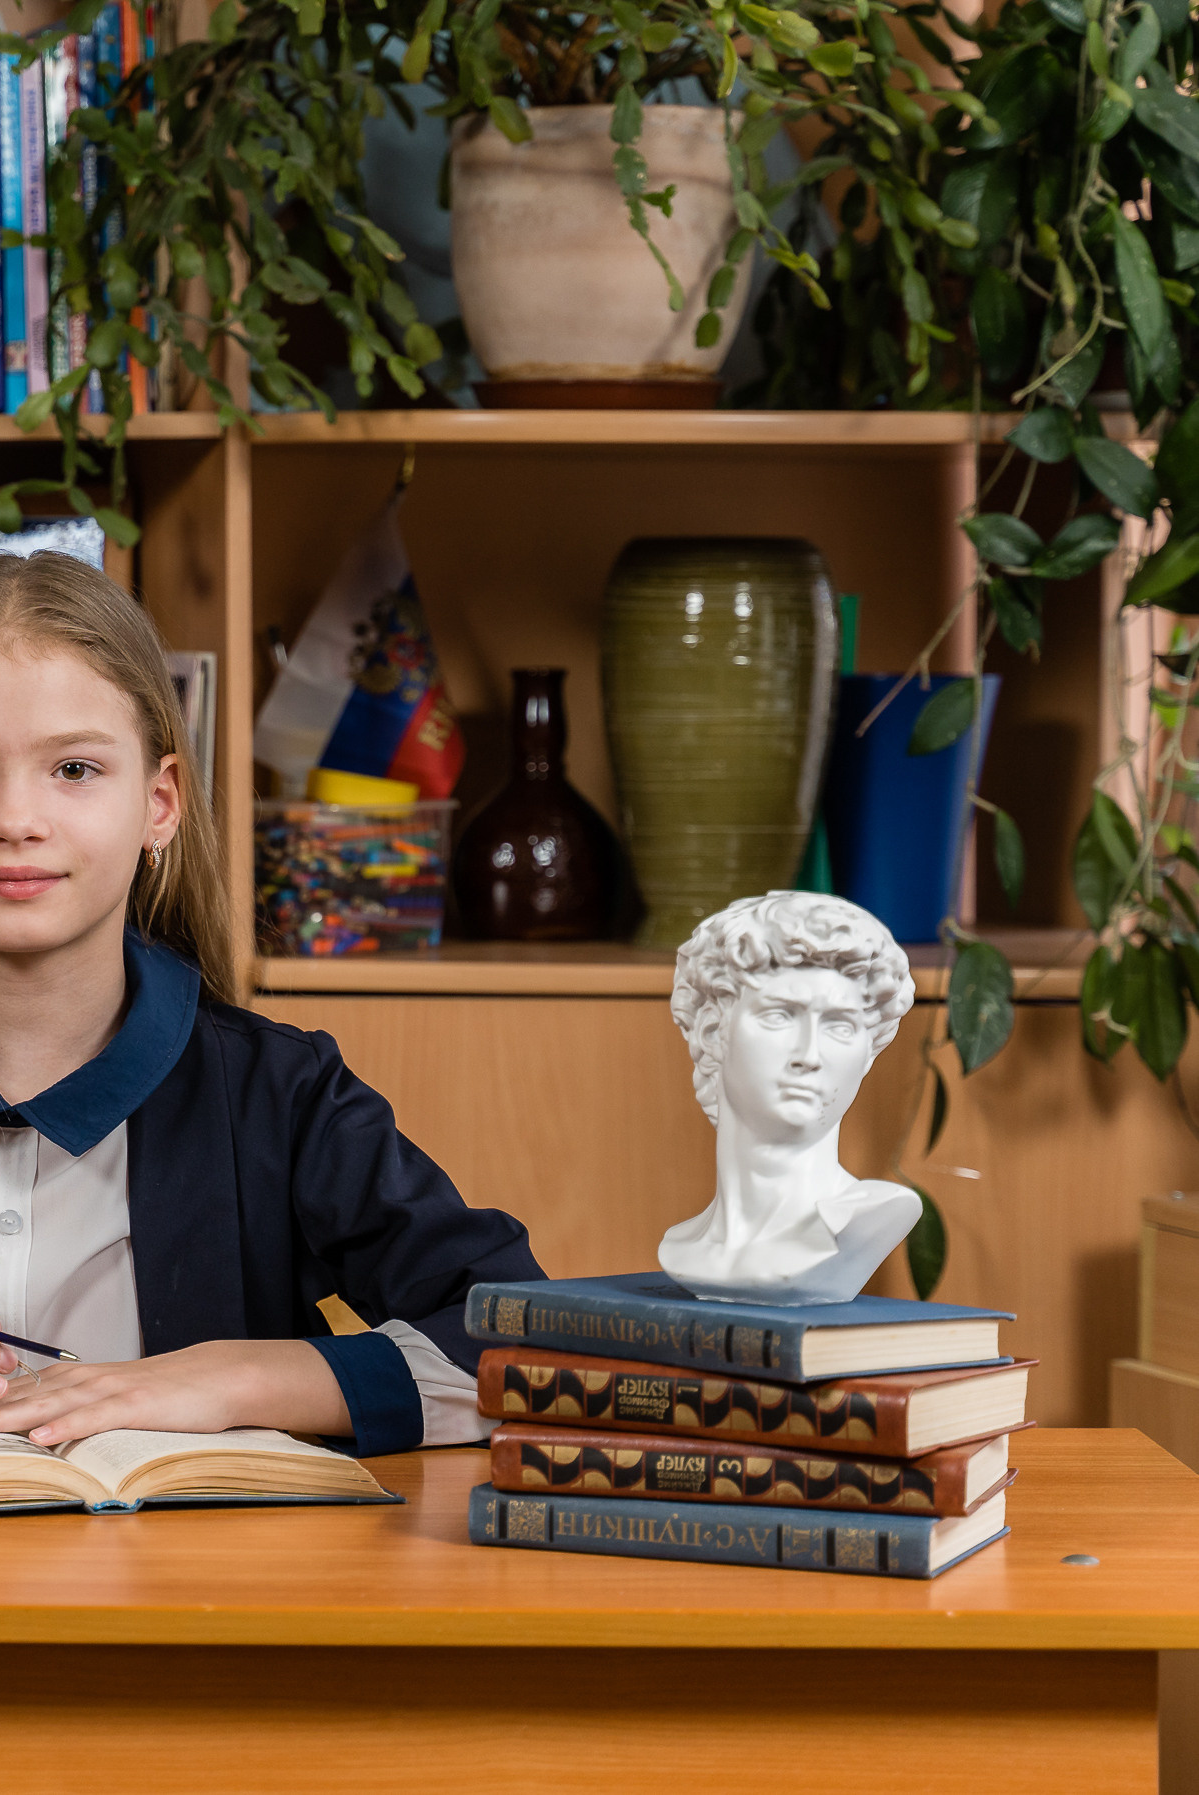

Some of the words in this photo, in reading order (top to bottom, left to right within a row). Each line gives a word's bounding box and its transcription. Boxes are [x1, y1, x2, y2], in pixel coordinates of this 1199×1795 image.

[28, 187, 41, 233] ОБРАЯ
[616, 1377, 671, 1393] КУПЕР
[655, 1454, 707, 1472] КУПЕР
